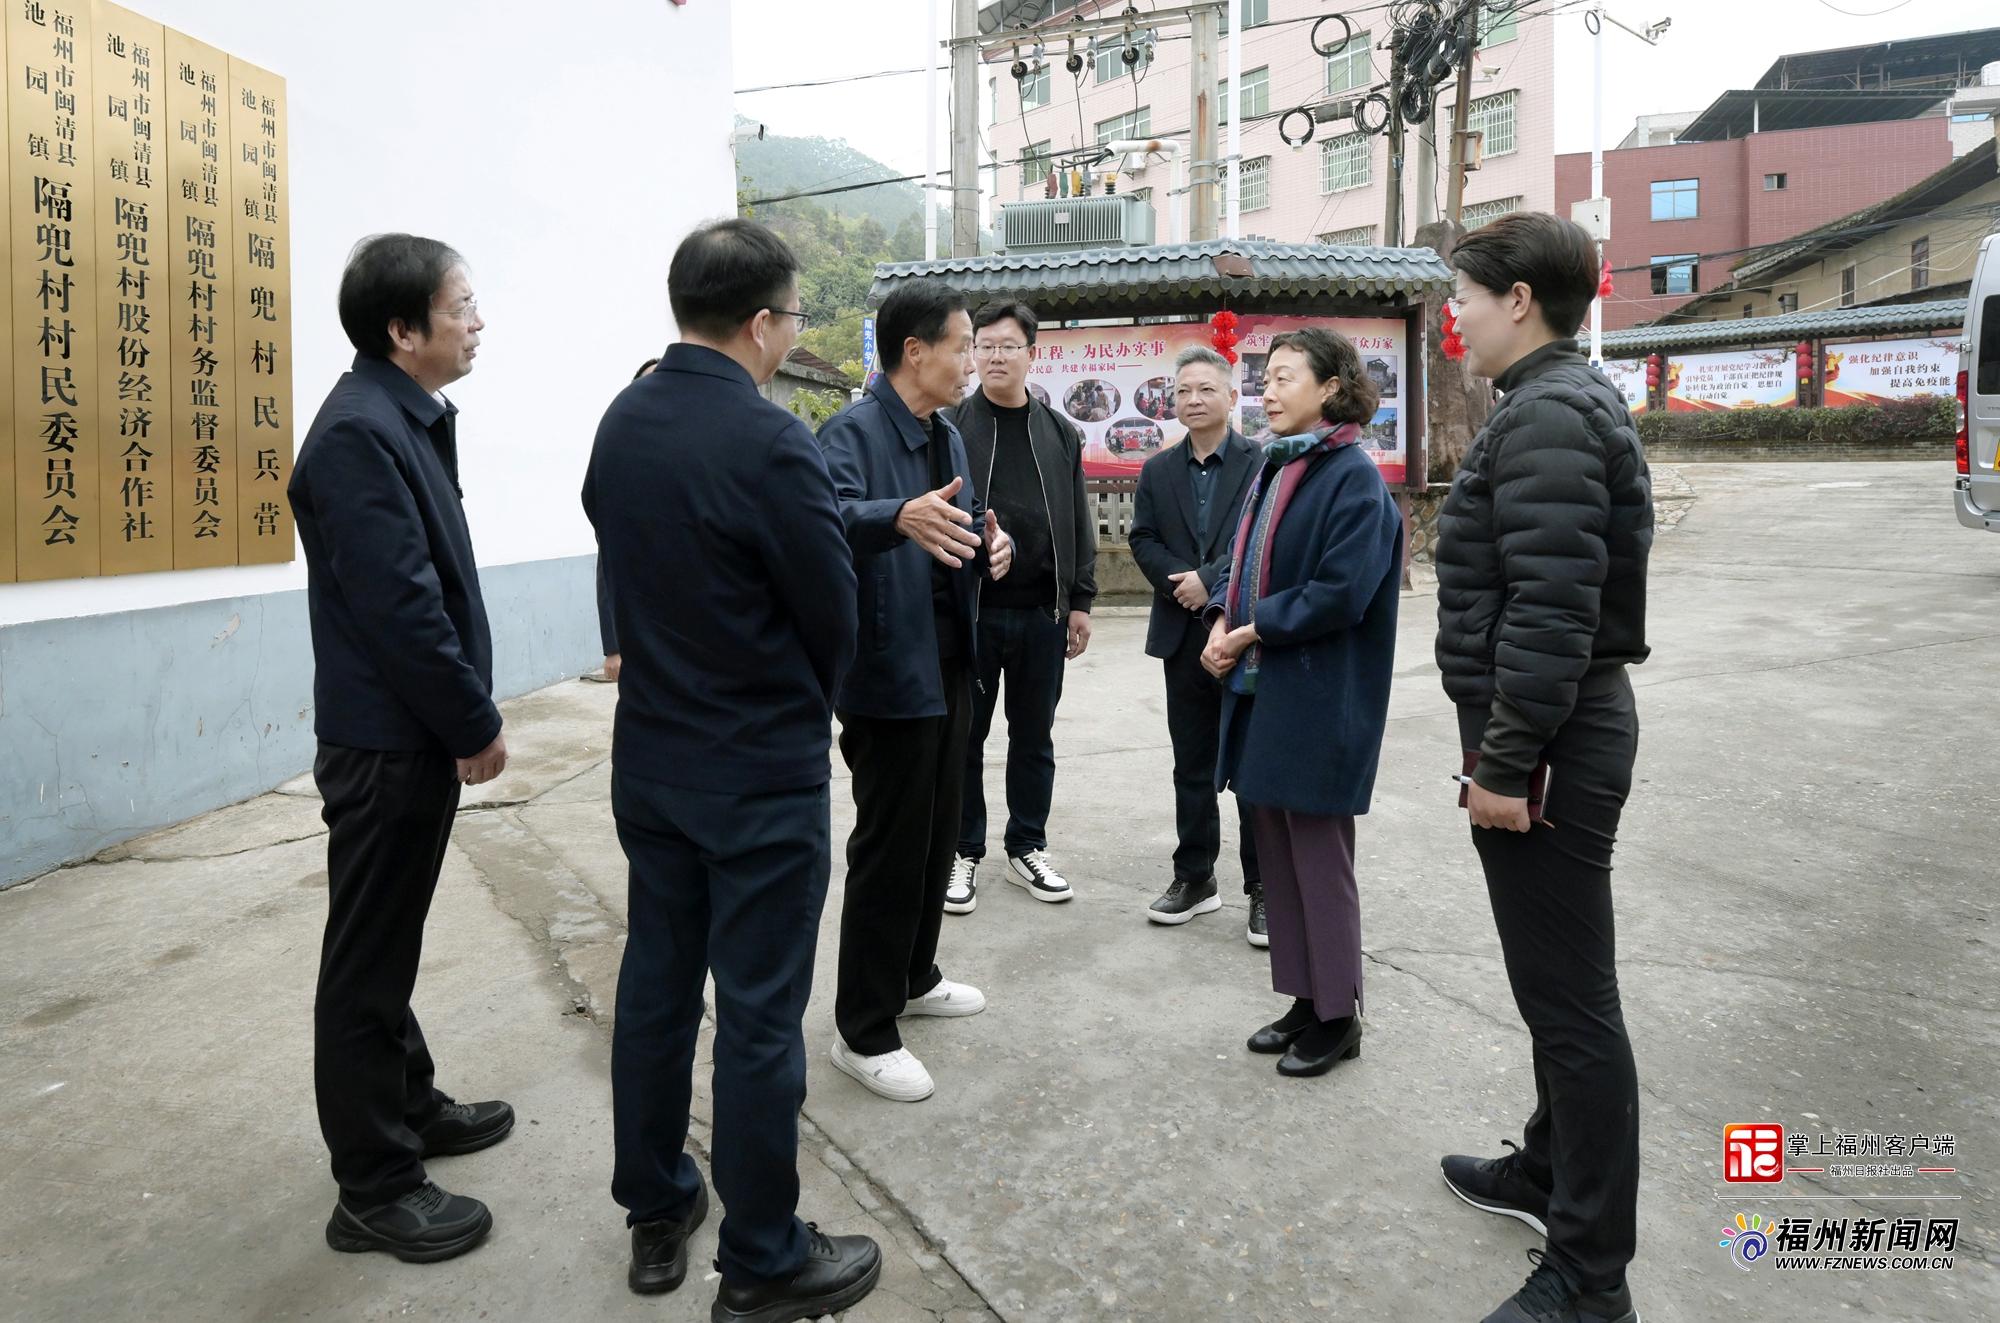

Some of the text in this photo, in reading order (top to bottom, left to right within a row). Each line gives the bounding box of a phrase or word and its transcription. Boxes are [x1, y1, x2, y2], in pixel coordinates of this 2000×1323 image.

[24, 0, 49, 160] 池园镇
[53, 10, 77, 167] 福州市闽清县
[107, 33, 128, 183] 池园镇
[131, 42, 152, 188] 福州市闽清县
[179, 62, 198, 202] 池园镇
[200, 70, 218, 207] 福州市闽清县
[242, 88, 259, 219] 池园镇
[261, 96, 278, 223] 福州市闽清县
[34, 176, 80, 545] 隔兜村村民委员会
[115, 197, 154, 542] 隔兜村股份经济合作社
[186, 216, 221, 538] 隔兜村村务监督委员会
[249, 232, 280, 537] 隔兜村民兵营
[1246, 334, 1276, 347] 筑牢
[1848, 351, 1918, 364] 强化纪律意识
[1870, 363, 1940, 376] 加强自我约束
[1890, 376, 1958, 388] 提高免疫能
